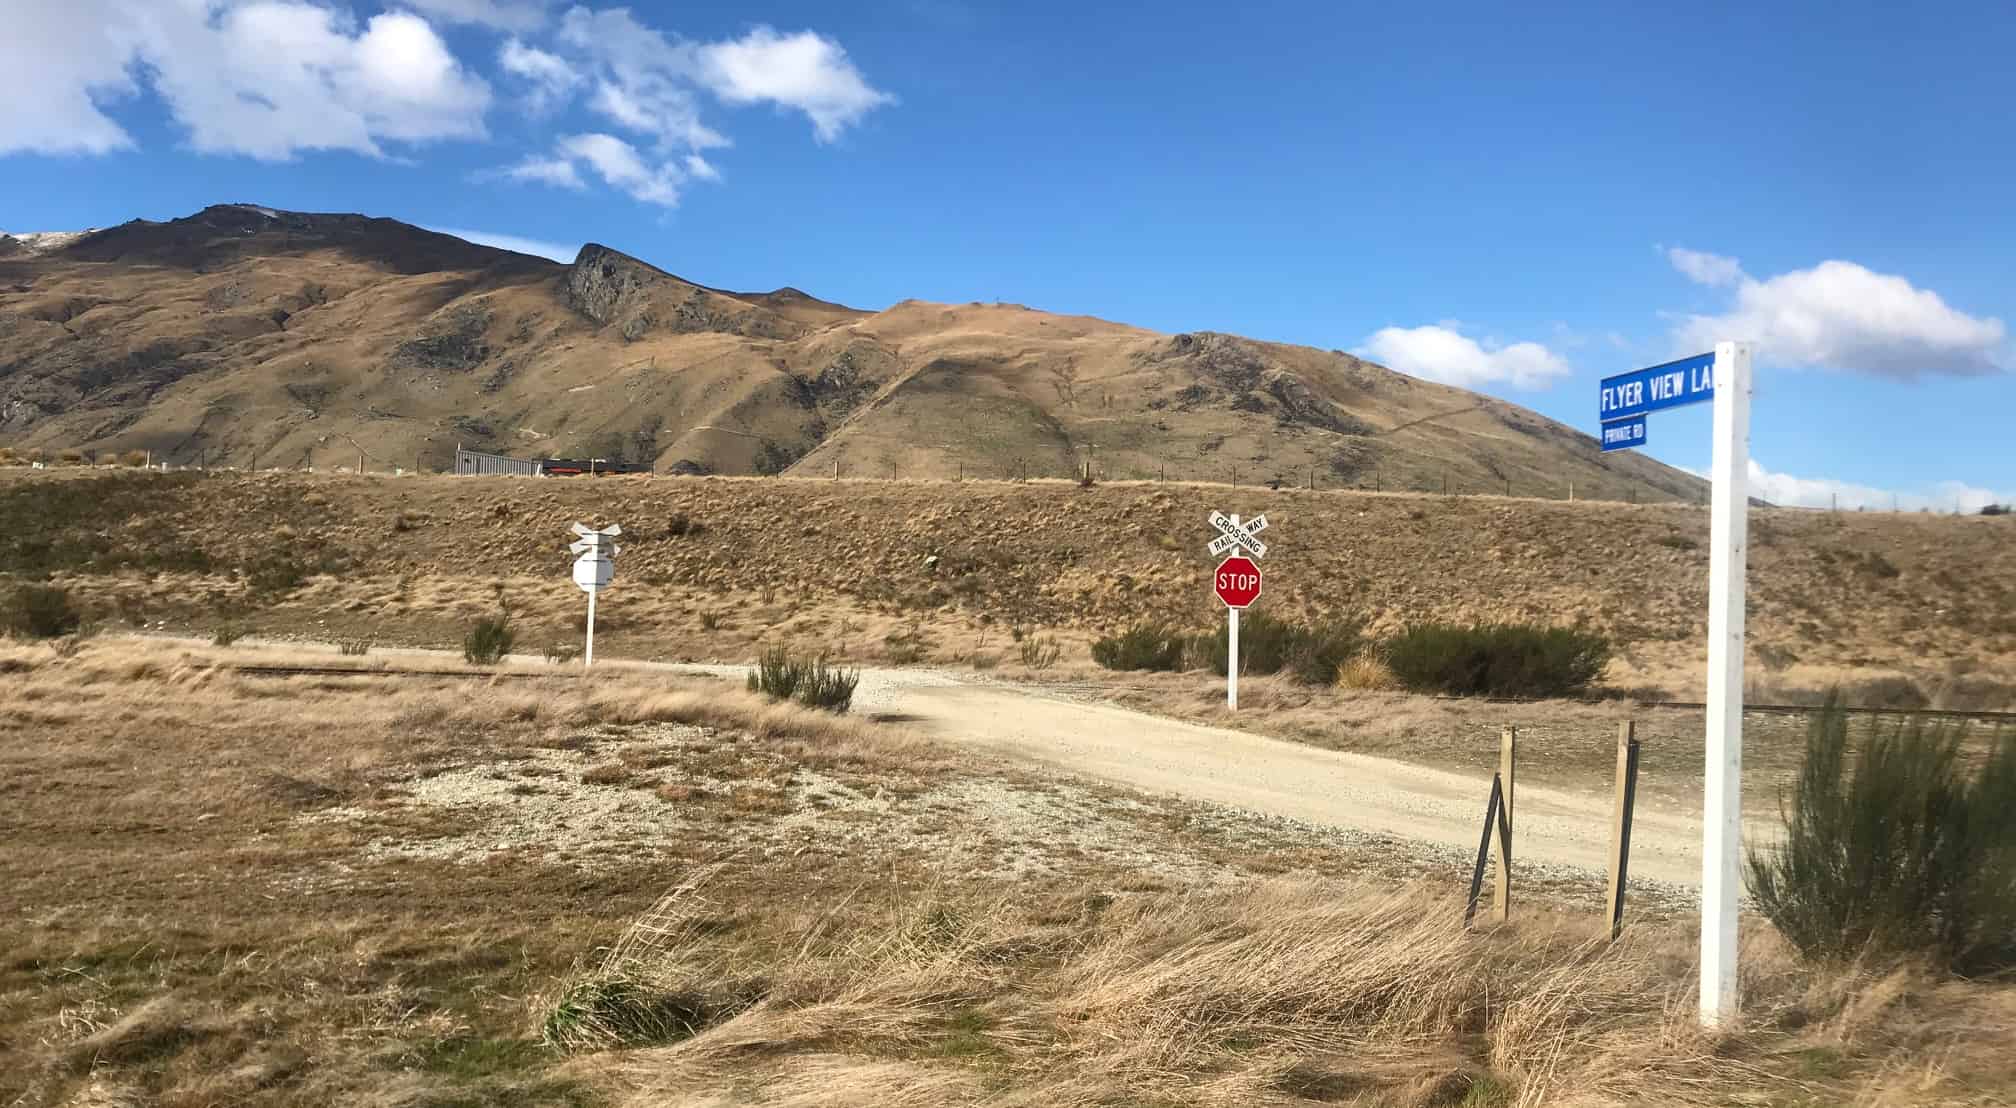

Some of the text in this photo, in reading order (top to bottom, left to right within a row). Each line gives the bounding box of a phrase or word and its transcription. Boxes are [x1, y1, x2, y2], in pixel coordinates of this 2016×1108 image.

[1601, 363, 1716, 412] FLYER VIEW LA
[1214, 518, 1263, 551] RAIL WAY
[1215, 516, 1261, 553] CROSSING
[1219, 572, 1258, 591] STOP
